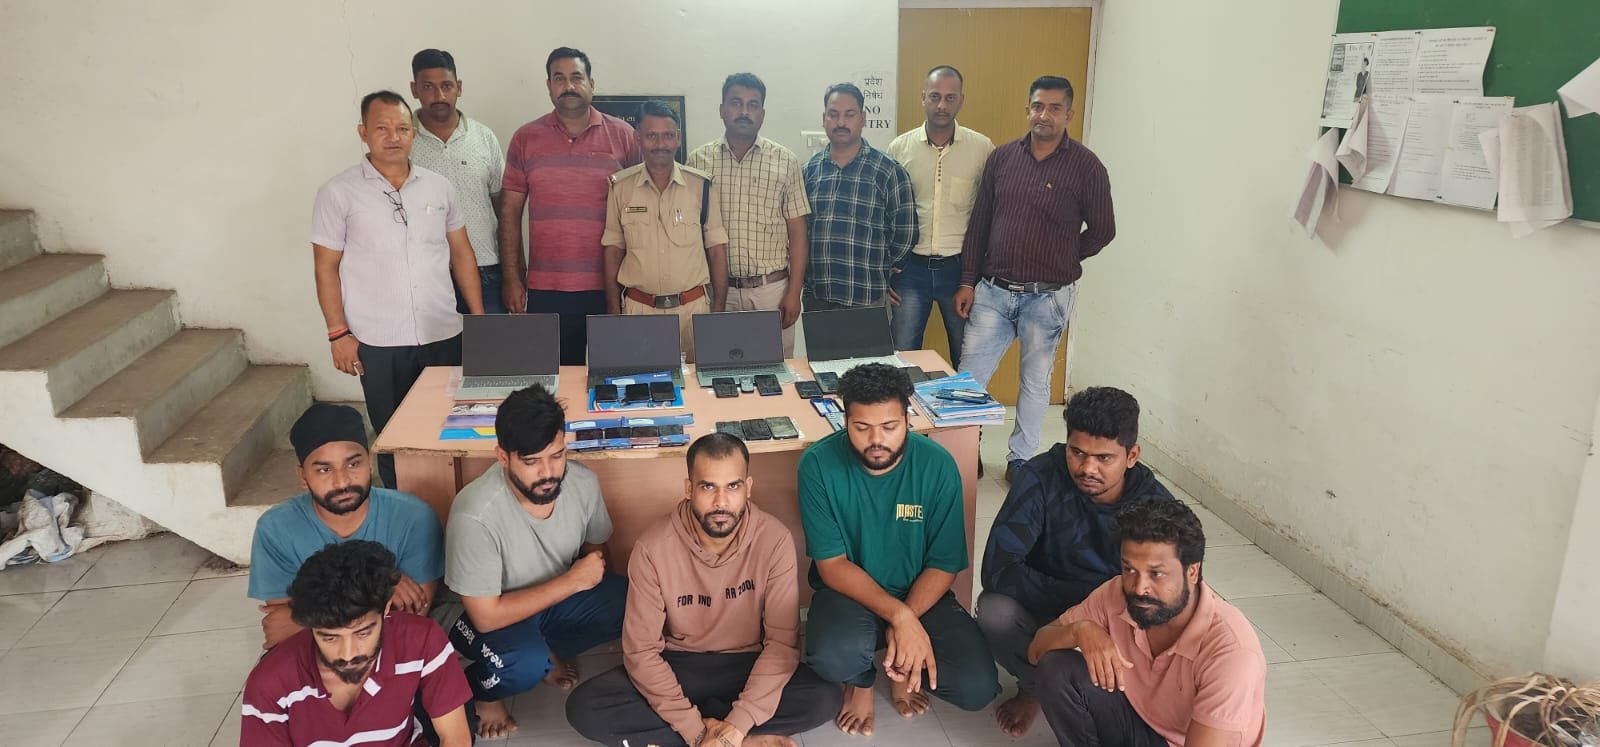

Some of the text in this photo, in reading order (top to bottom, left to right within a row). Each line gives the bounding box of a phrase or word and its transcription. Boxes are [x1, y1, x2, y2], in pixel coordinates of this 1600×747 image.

[864, 106, 881, 115] NO
[868, 119, 892, 129] TRY
[677, 594, 693, 608] FOR
